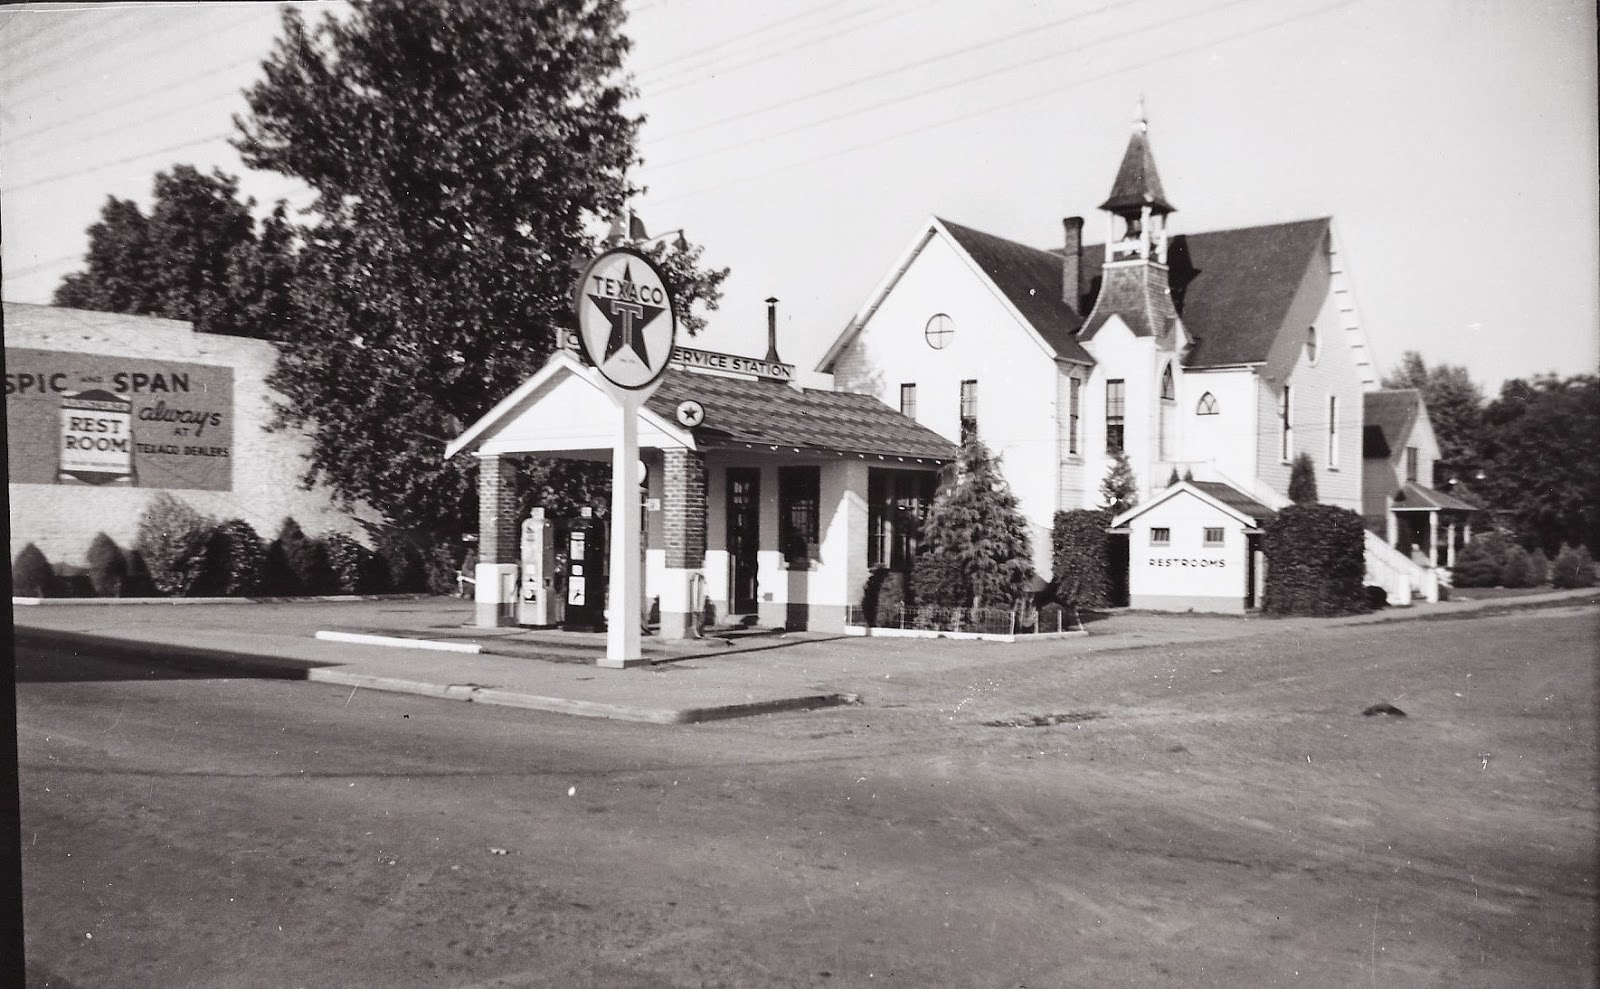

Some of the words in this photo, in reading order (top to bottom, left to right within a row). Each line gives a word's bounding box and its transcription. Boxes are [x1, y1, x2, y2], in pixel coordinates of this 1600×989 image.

[592, 275, 665, 305] TEXACO
[671, 348, 728, 368] ERVICE
[732, 358, 791, 378] STATION
[113, 371, 191, 393] SPAN
[69, 416, 123, 434] REST
[138, 400, 222, 437] always
[174, 428, 191, 437] AT
[65, 434, 129, 453] ROOM
[136, 443, 180, 455] TEXACO
[183, 446, 230, 457] DEALERS
[1149, 558, 1226, 568] RESTROOMS
